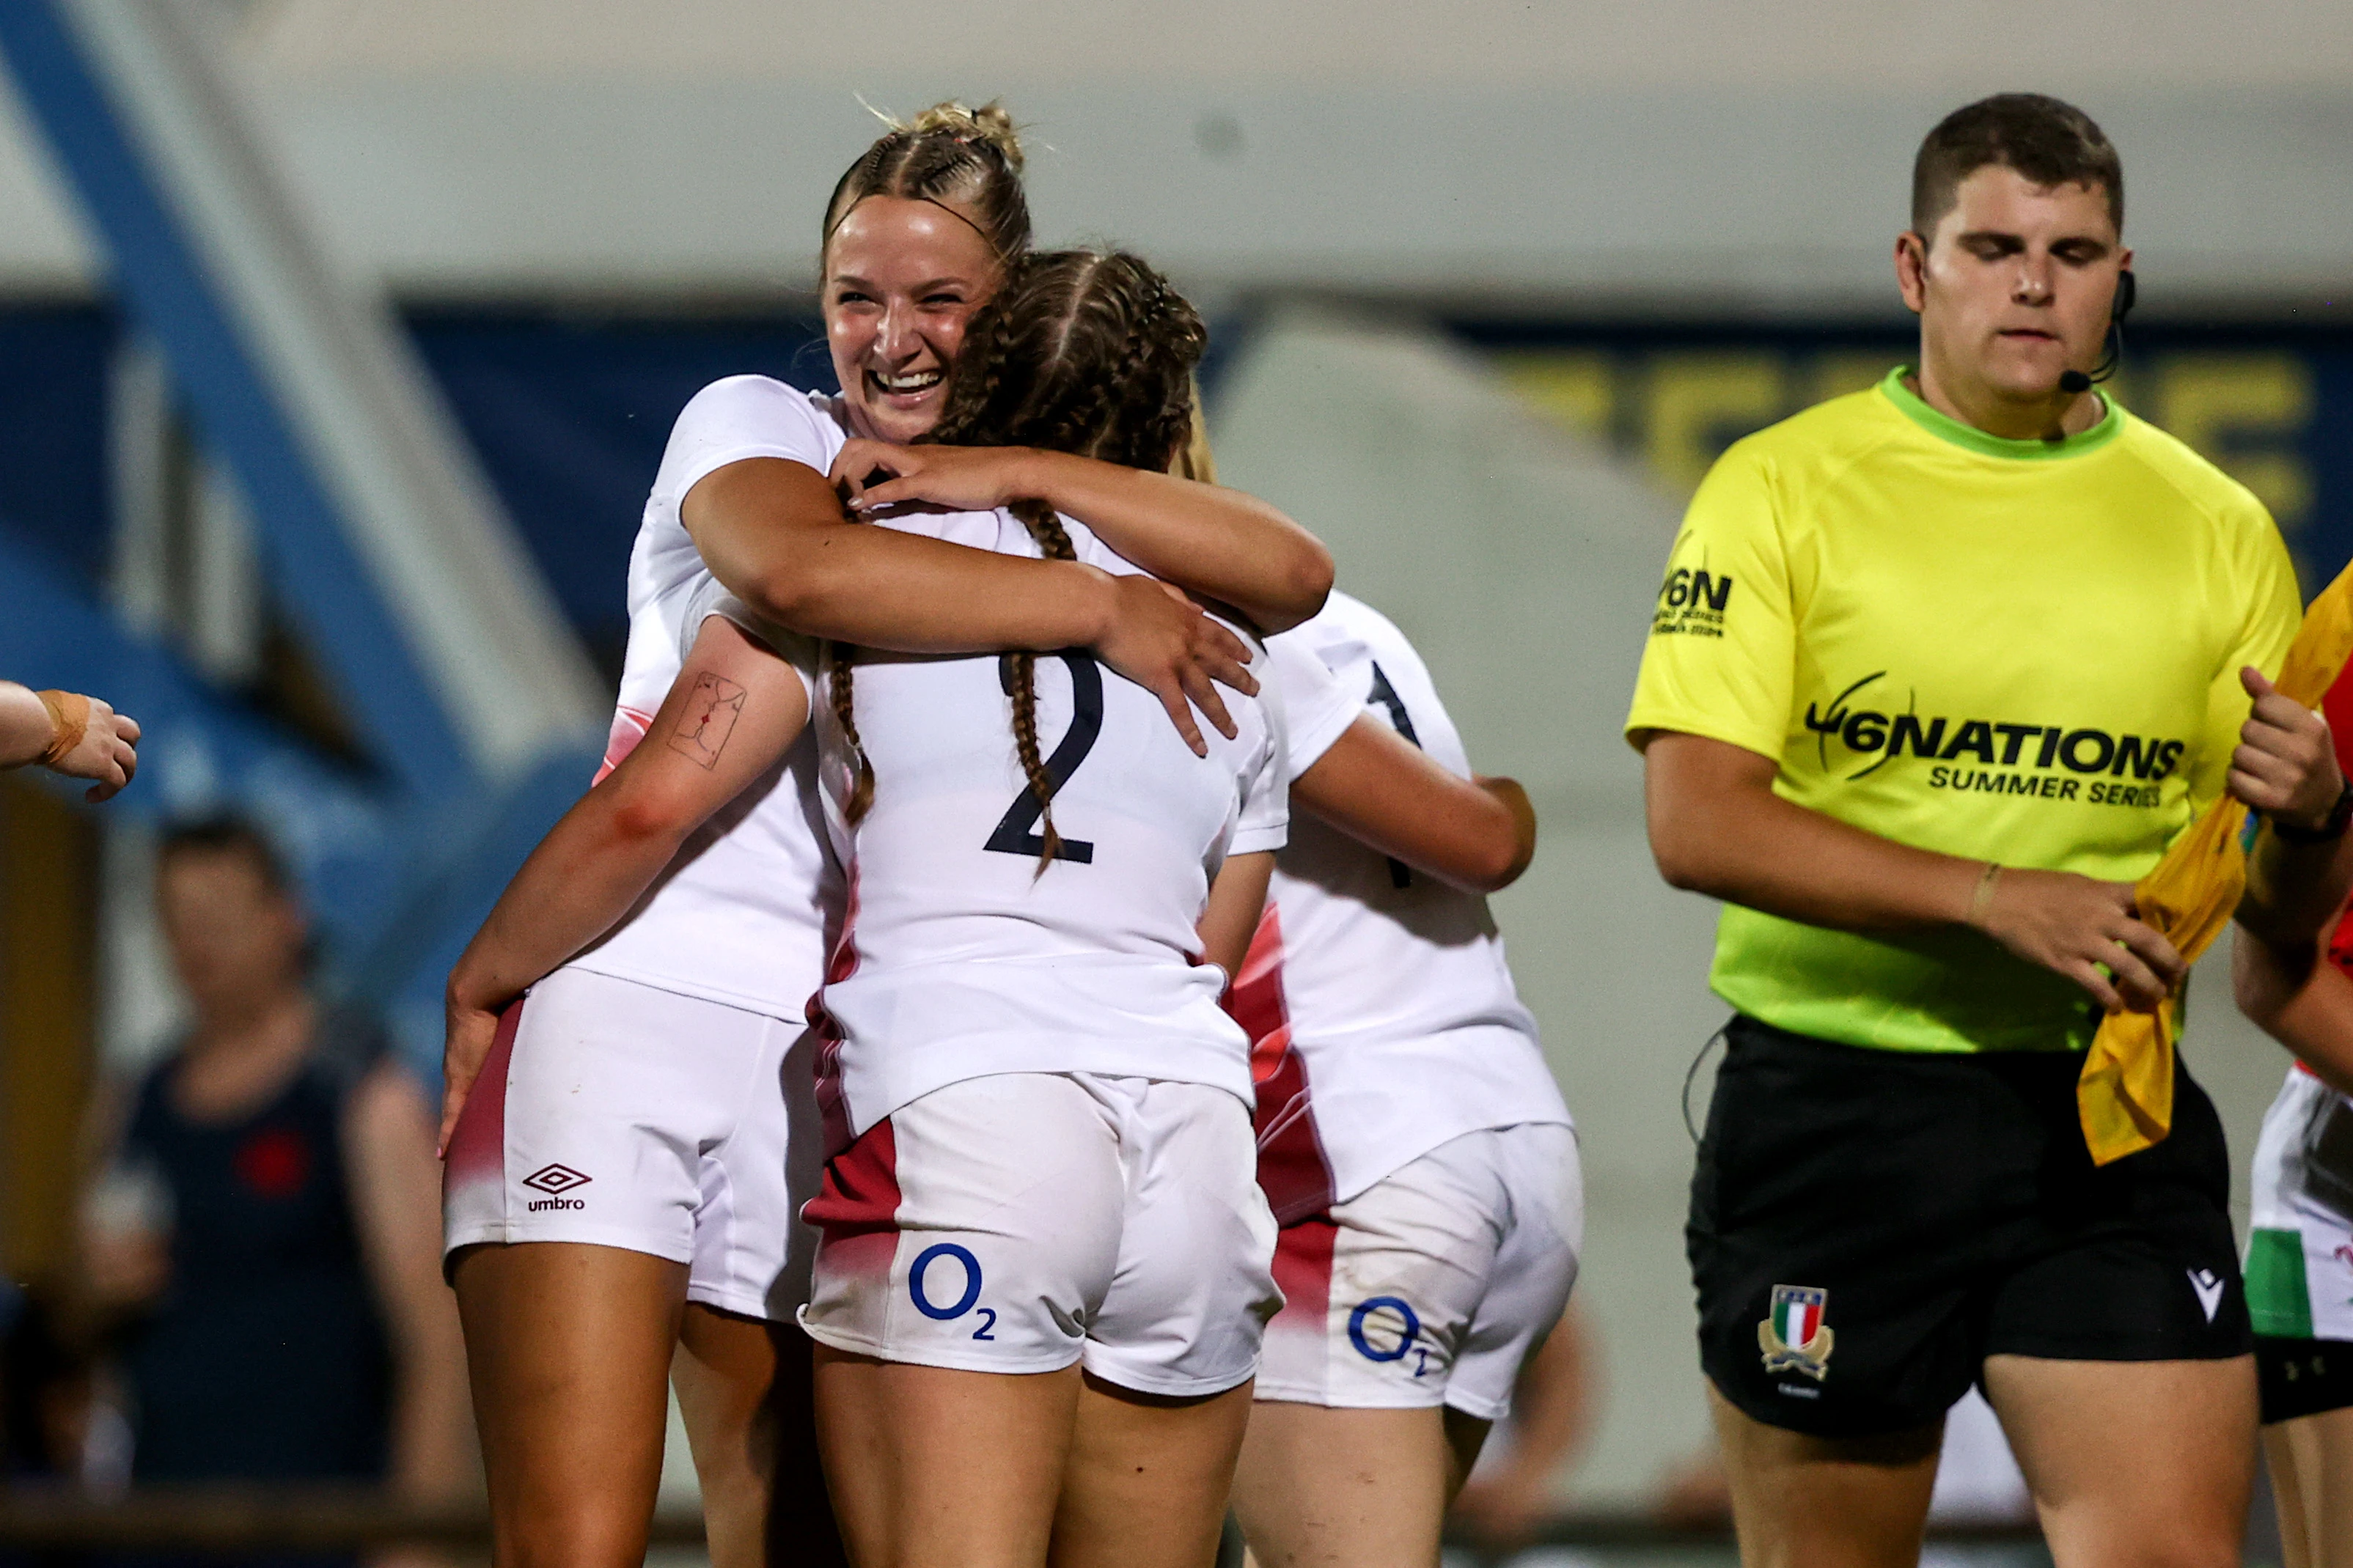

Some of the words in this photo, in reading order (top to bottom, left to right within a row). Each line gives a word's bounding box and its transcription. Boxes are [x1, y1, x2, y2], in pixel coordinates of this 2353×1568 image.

[983, 648, 1104, 864] 2
[1928, 766, 2080, 802] SUMMER
[2087, 781, 2161, 807] SERIES
[528, 1196, 585, 1212] umbro
